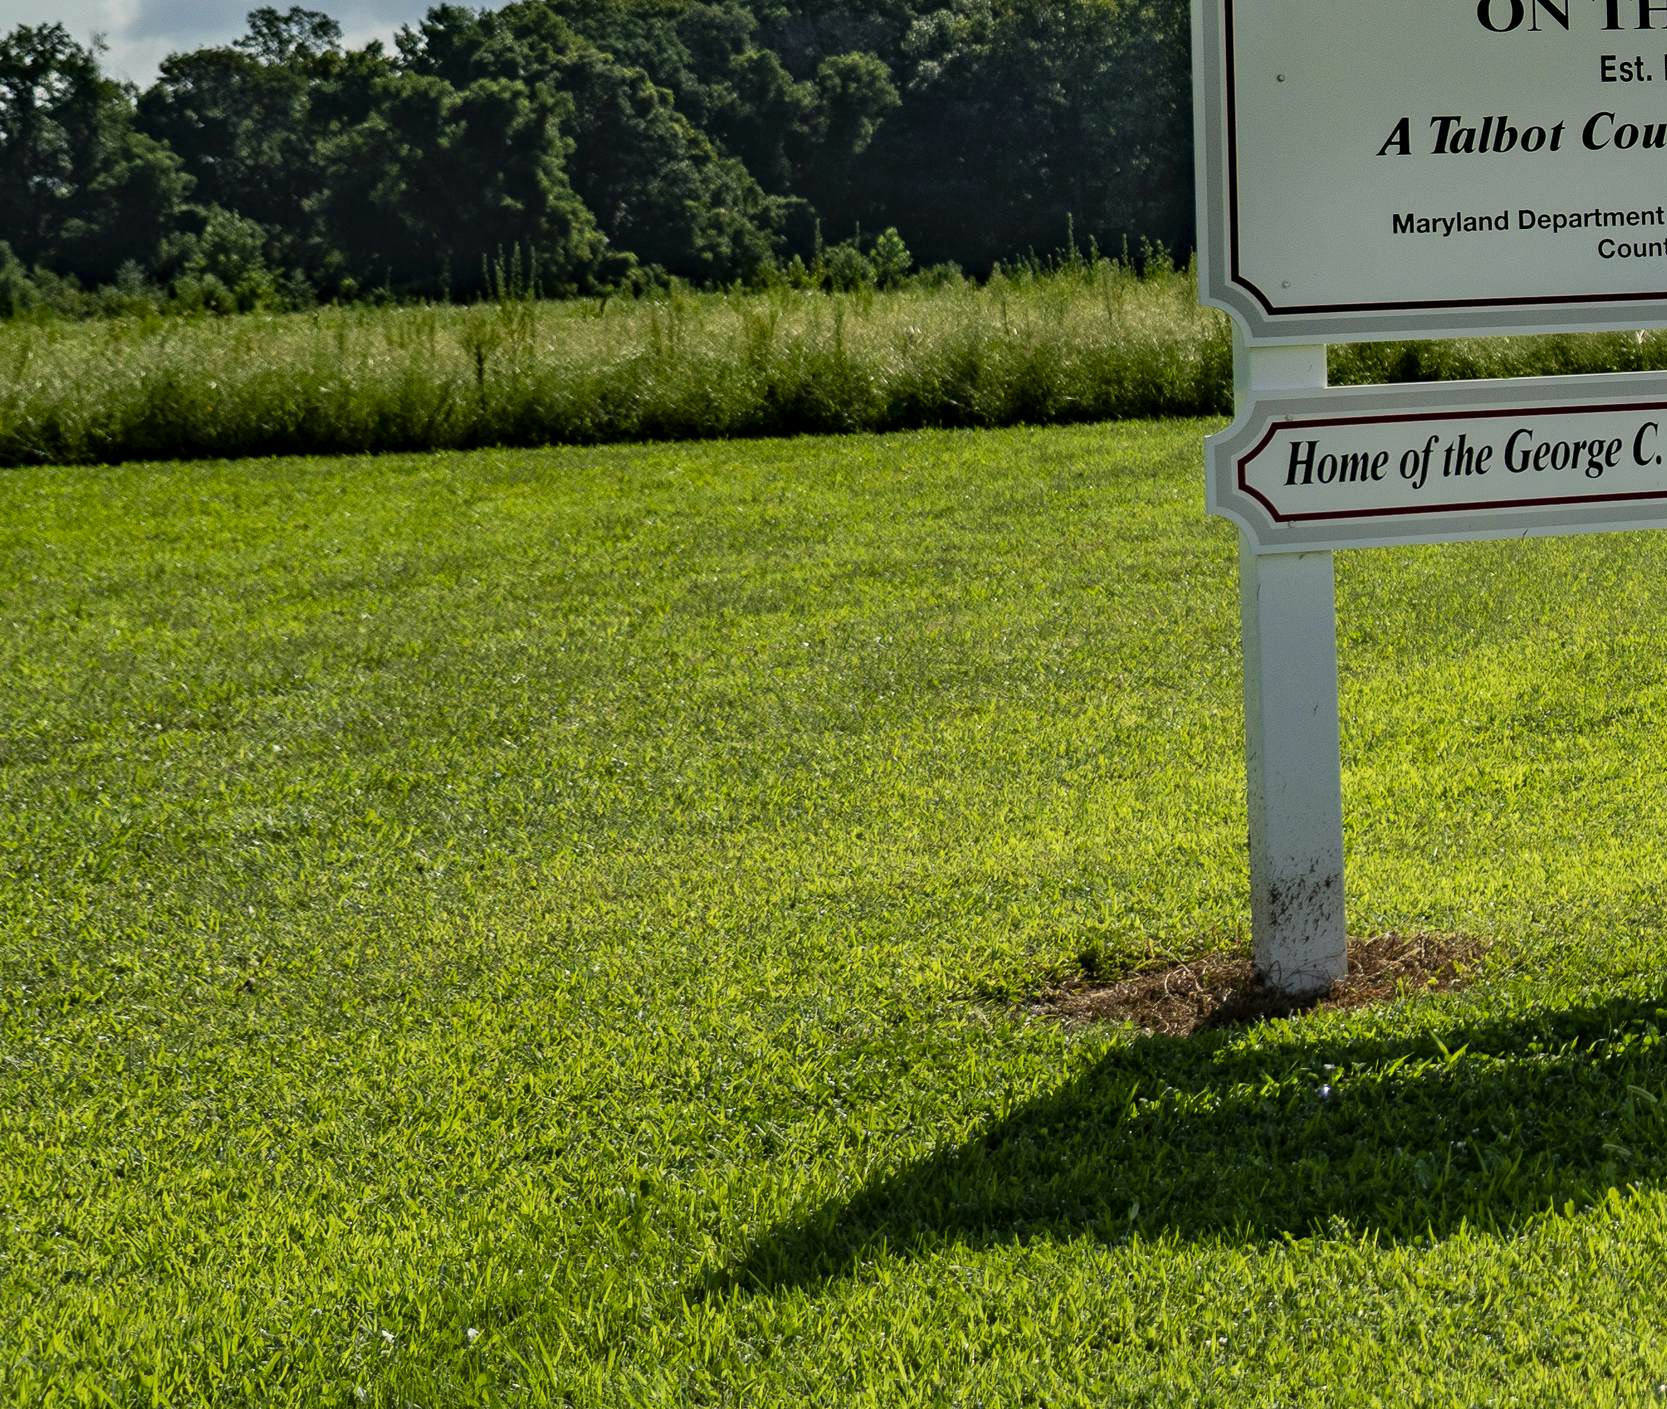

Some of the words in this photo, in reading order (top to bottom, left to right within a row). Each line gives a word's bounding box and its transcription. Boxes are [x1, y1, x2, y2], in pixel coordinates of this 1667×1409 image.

[1600, 54, 1653, 83] Est.
[1375, 117, 1412, 157] A
[1429, 115, 1566, 155] Talbot
[1392, 210, 1509, 238] Maryland
[1518, 206, 1665, 234] Department
[1283, 439, 1389, 486] Home
[1399, 434, 1440, 490] of
[1442, 433, 1493, 478] the
[1504, 428, 1623, 479] George
[1632, 421, 1662, 467] C.
